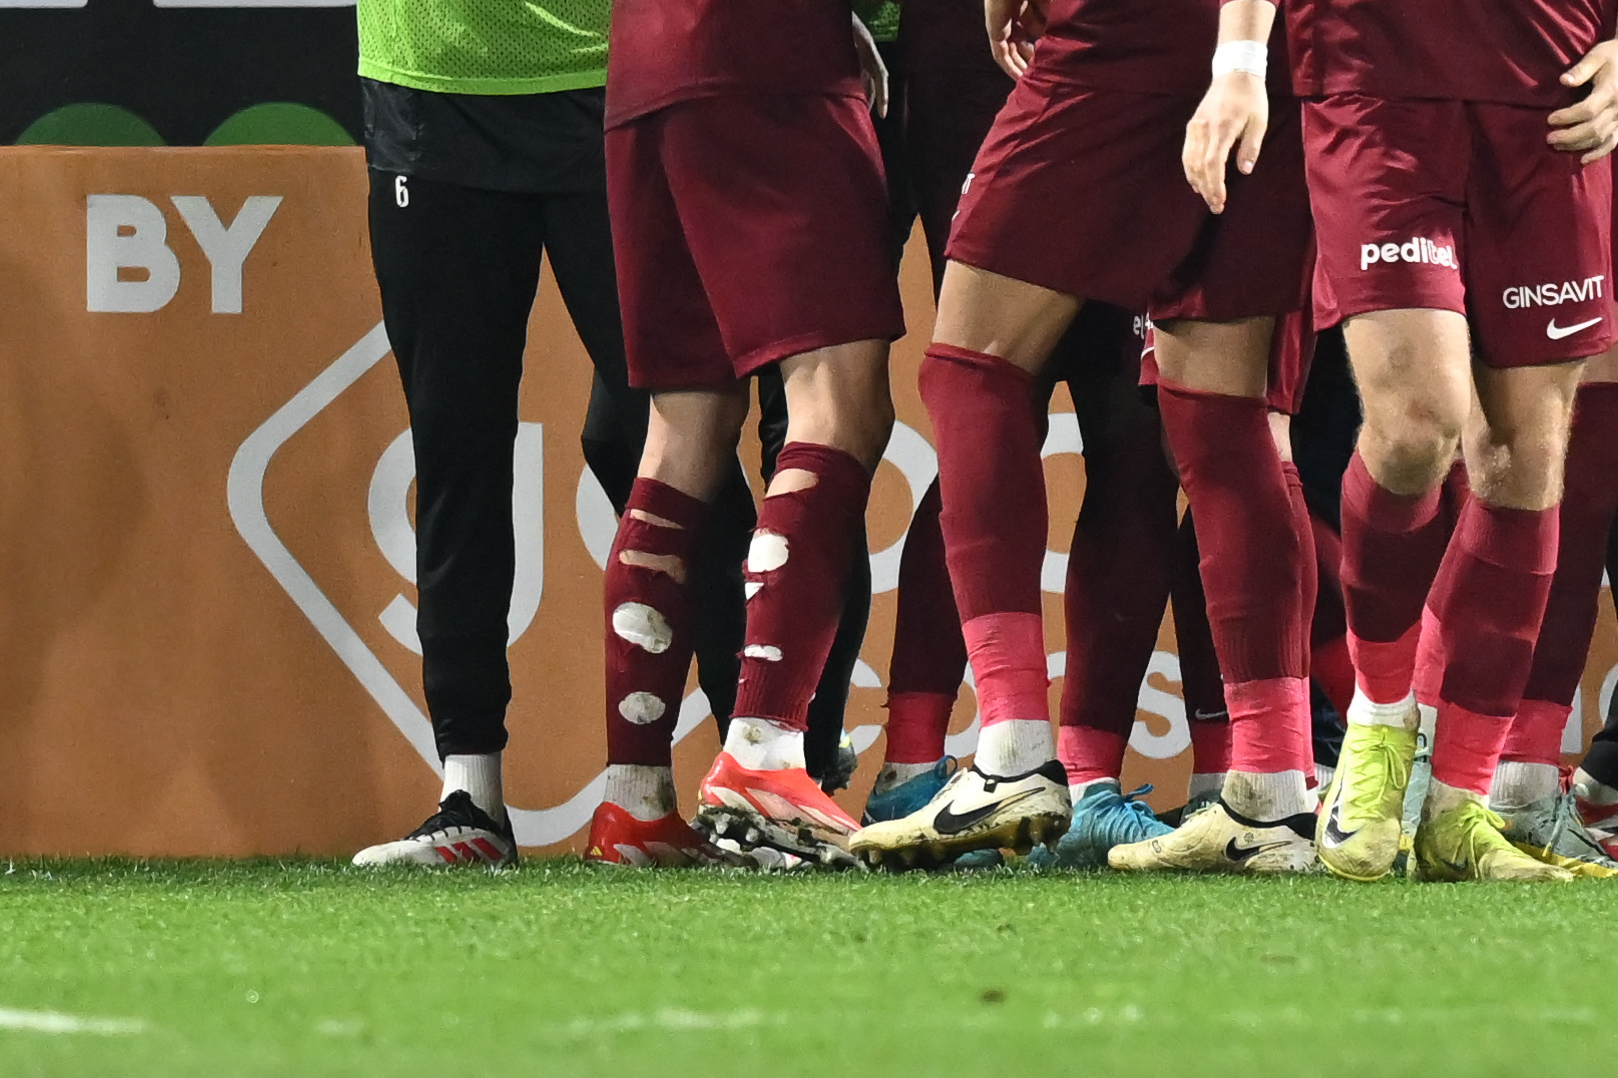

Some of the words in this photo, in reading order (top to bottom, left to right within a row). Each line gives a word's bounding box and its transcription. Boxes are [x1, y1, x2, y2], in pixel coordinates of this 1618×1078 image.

[395, 175, 409, 208] 6
[86, 194, 283, 314] BY
[1502, 275, 1605, 310] GINSAVIT
